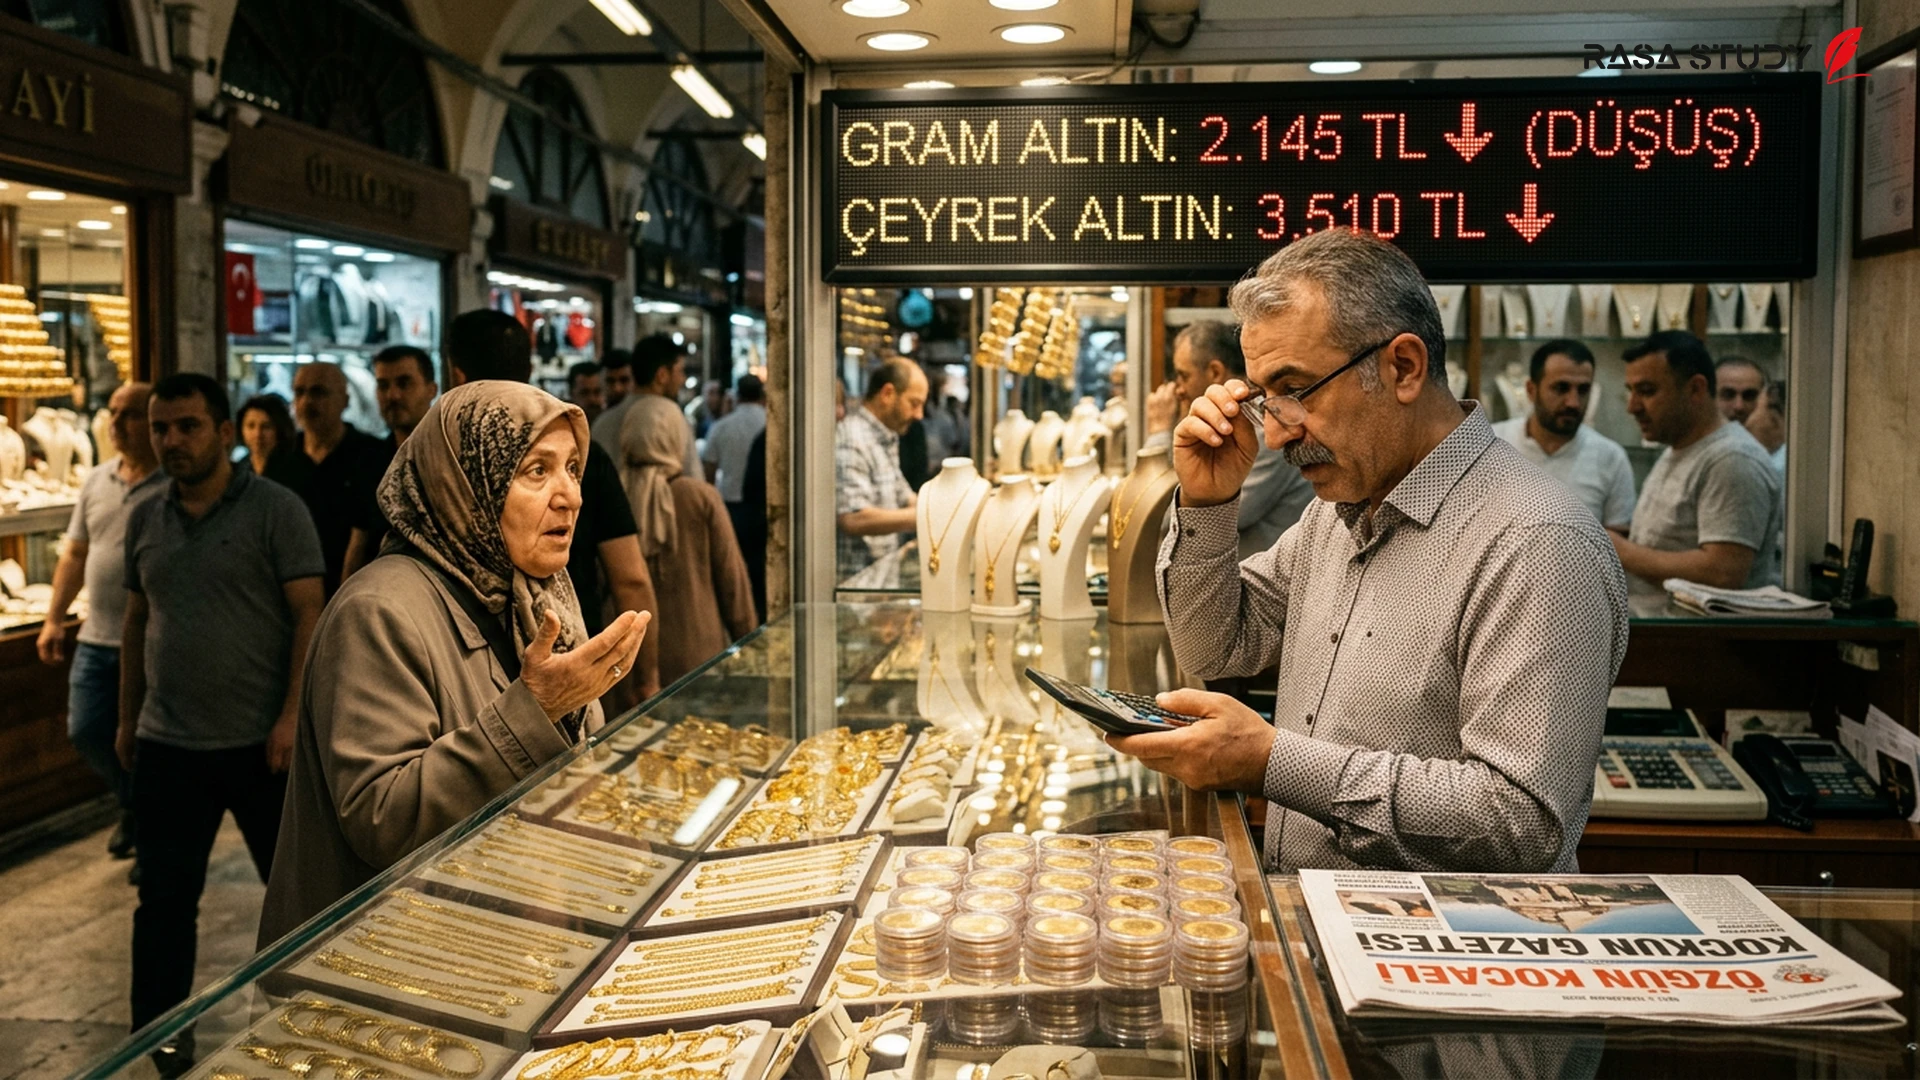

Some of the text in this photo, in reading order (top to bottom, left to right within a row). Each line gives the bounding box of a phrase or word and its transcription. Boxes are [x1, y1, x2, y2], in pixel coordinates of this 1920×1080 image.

[0, 67, 96, 135] AYİ
[842, 99, 1761, 169] GRAM ALTIN: 2.145 TL (DÜŞÜŞ)
[842, 191, 1486, 257] ÇEYREK ALTIN: 3.510 TL
[1361, 931, 1809, 957] KOCKUN GAZETESİ
[1375, 962, 1584, 988] KOCAELİ
[1593, 968, 1769, 994] ÖZGÜN
